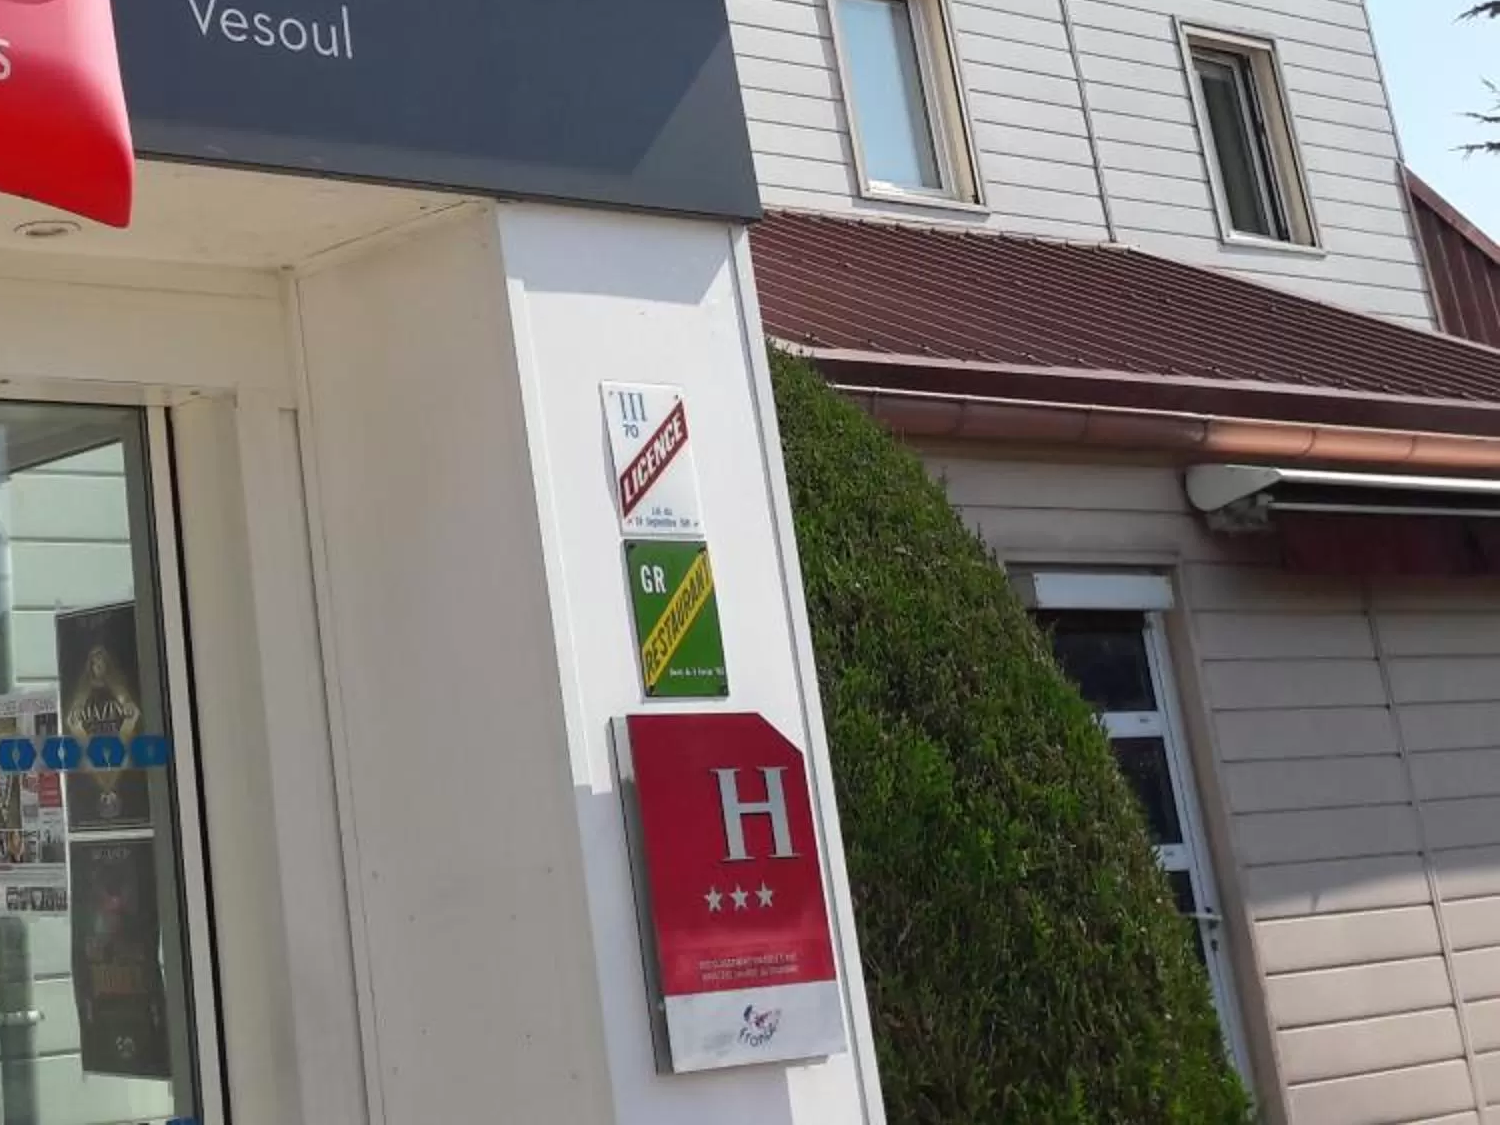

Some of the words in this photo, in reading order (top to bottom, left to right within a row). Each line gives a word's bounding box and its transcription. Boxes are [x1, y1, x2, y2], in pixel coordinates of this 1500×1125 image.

[623, 412, 684, 505] LICENCE
[640, 563, 667, 594] GR
[709, 765, 803, 861] H
